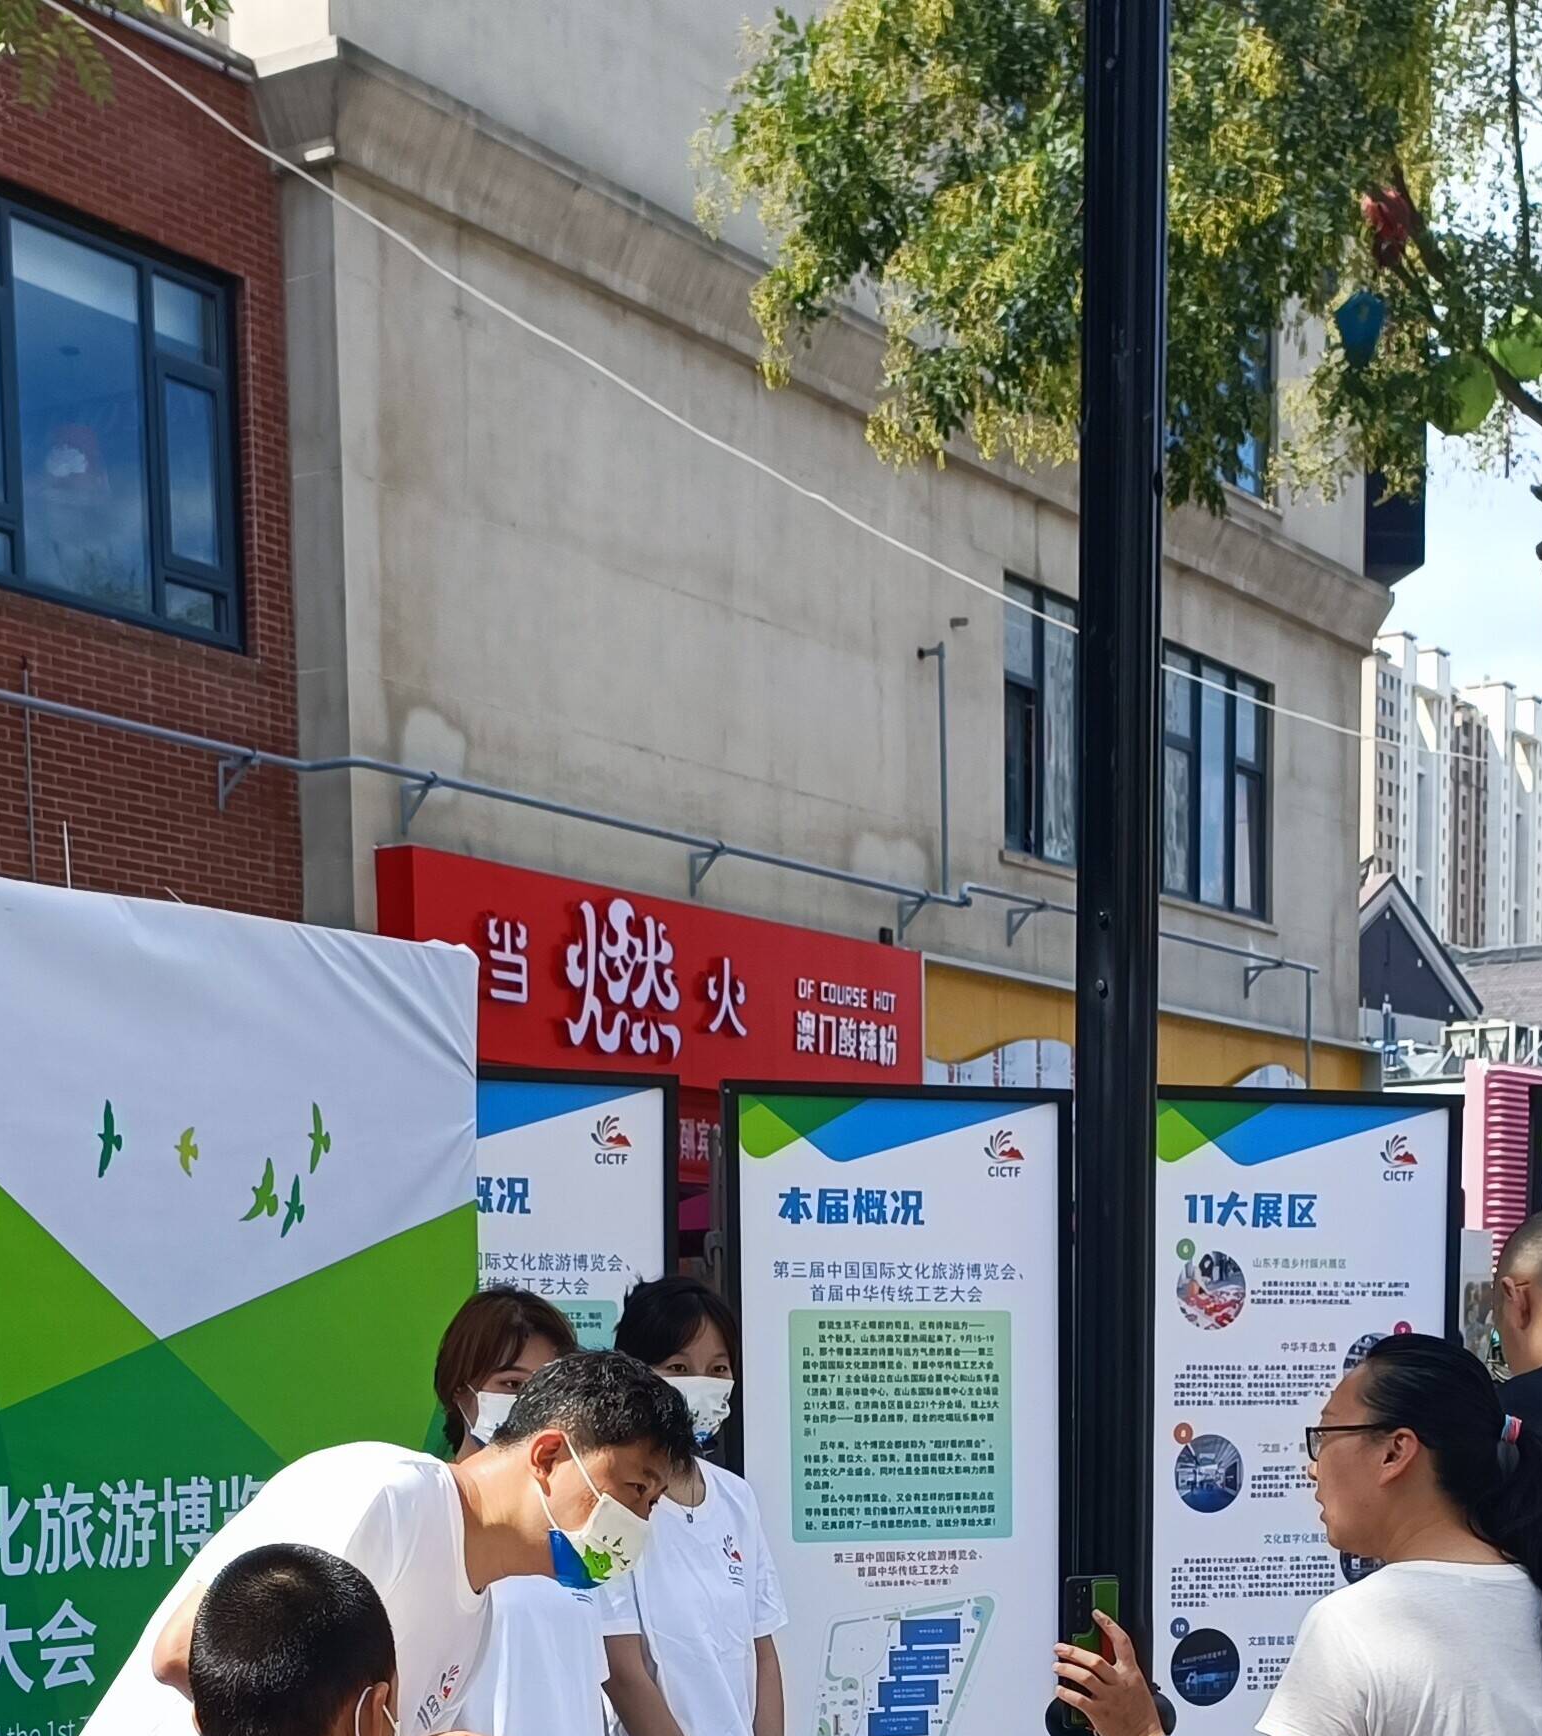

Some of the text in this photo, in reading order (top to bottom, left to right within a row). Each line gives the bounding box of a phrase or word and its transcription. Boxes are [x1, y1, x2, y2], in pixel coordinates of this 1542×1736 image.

[797, 977, 897, 1014] OF COURSE HOT
[795, 1011, 898, 1067] 澳门酸辣粉
[594, 1152, 628, 1165] CICTF
[987, 1166, 1021, 1178] CICTF
[1382, 1170, 1414, 1182] CICTF
[778, 1186, 925, 1226] 本届概况
[1184, 1191, 1318, 1229] 11大展区
[477, 1252, 632, 1273] 际文化旅游博览会、
[773, 1260, 1025, 1281] 第三届中国国际文化旅游博览会、
[810, 1283, 983, 1303] 首届中华传统工艺大会
[1175, 1623, 1185, 1633] 10
